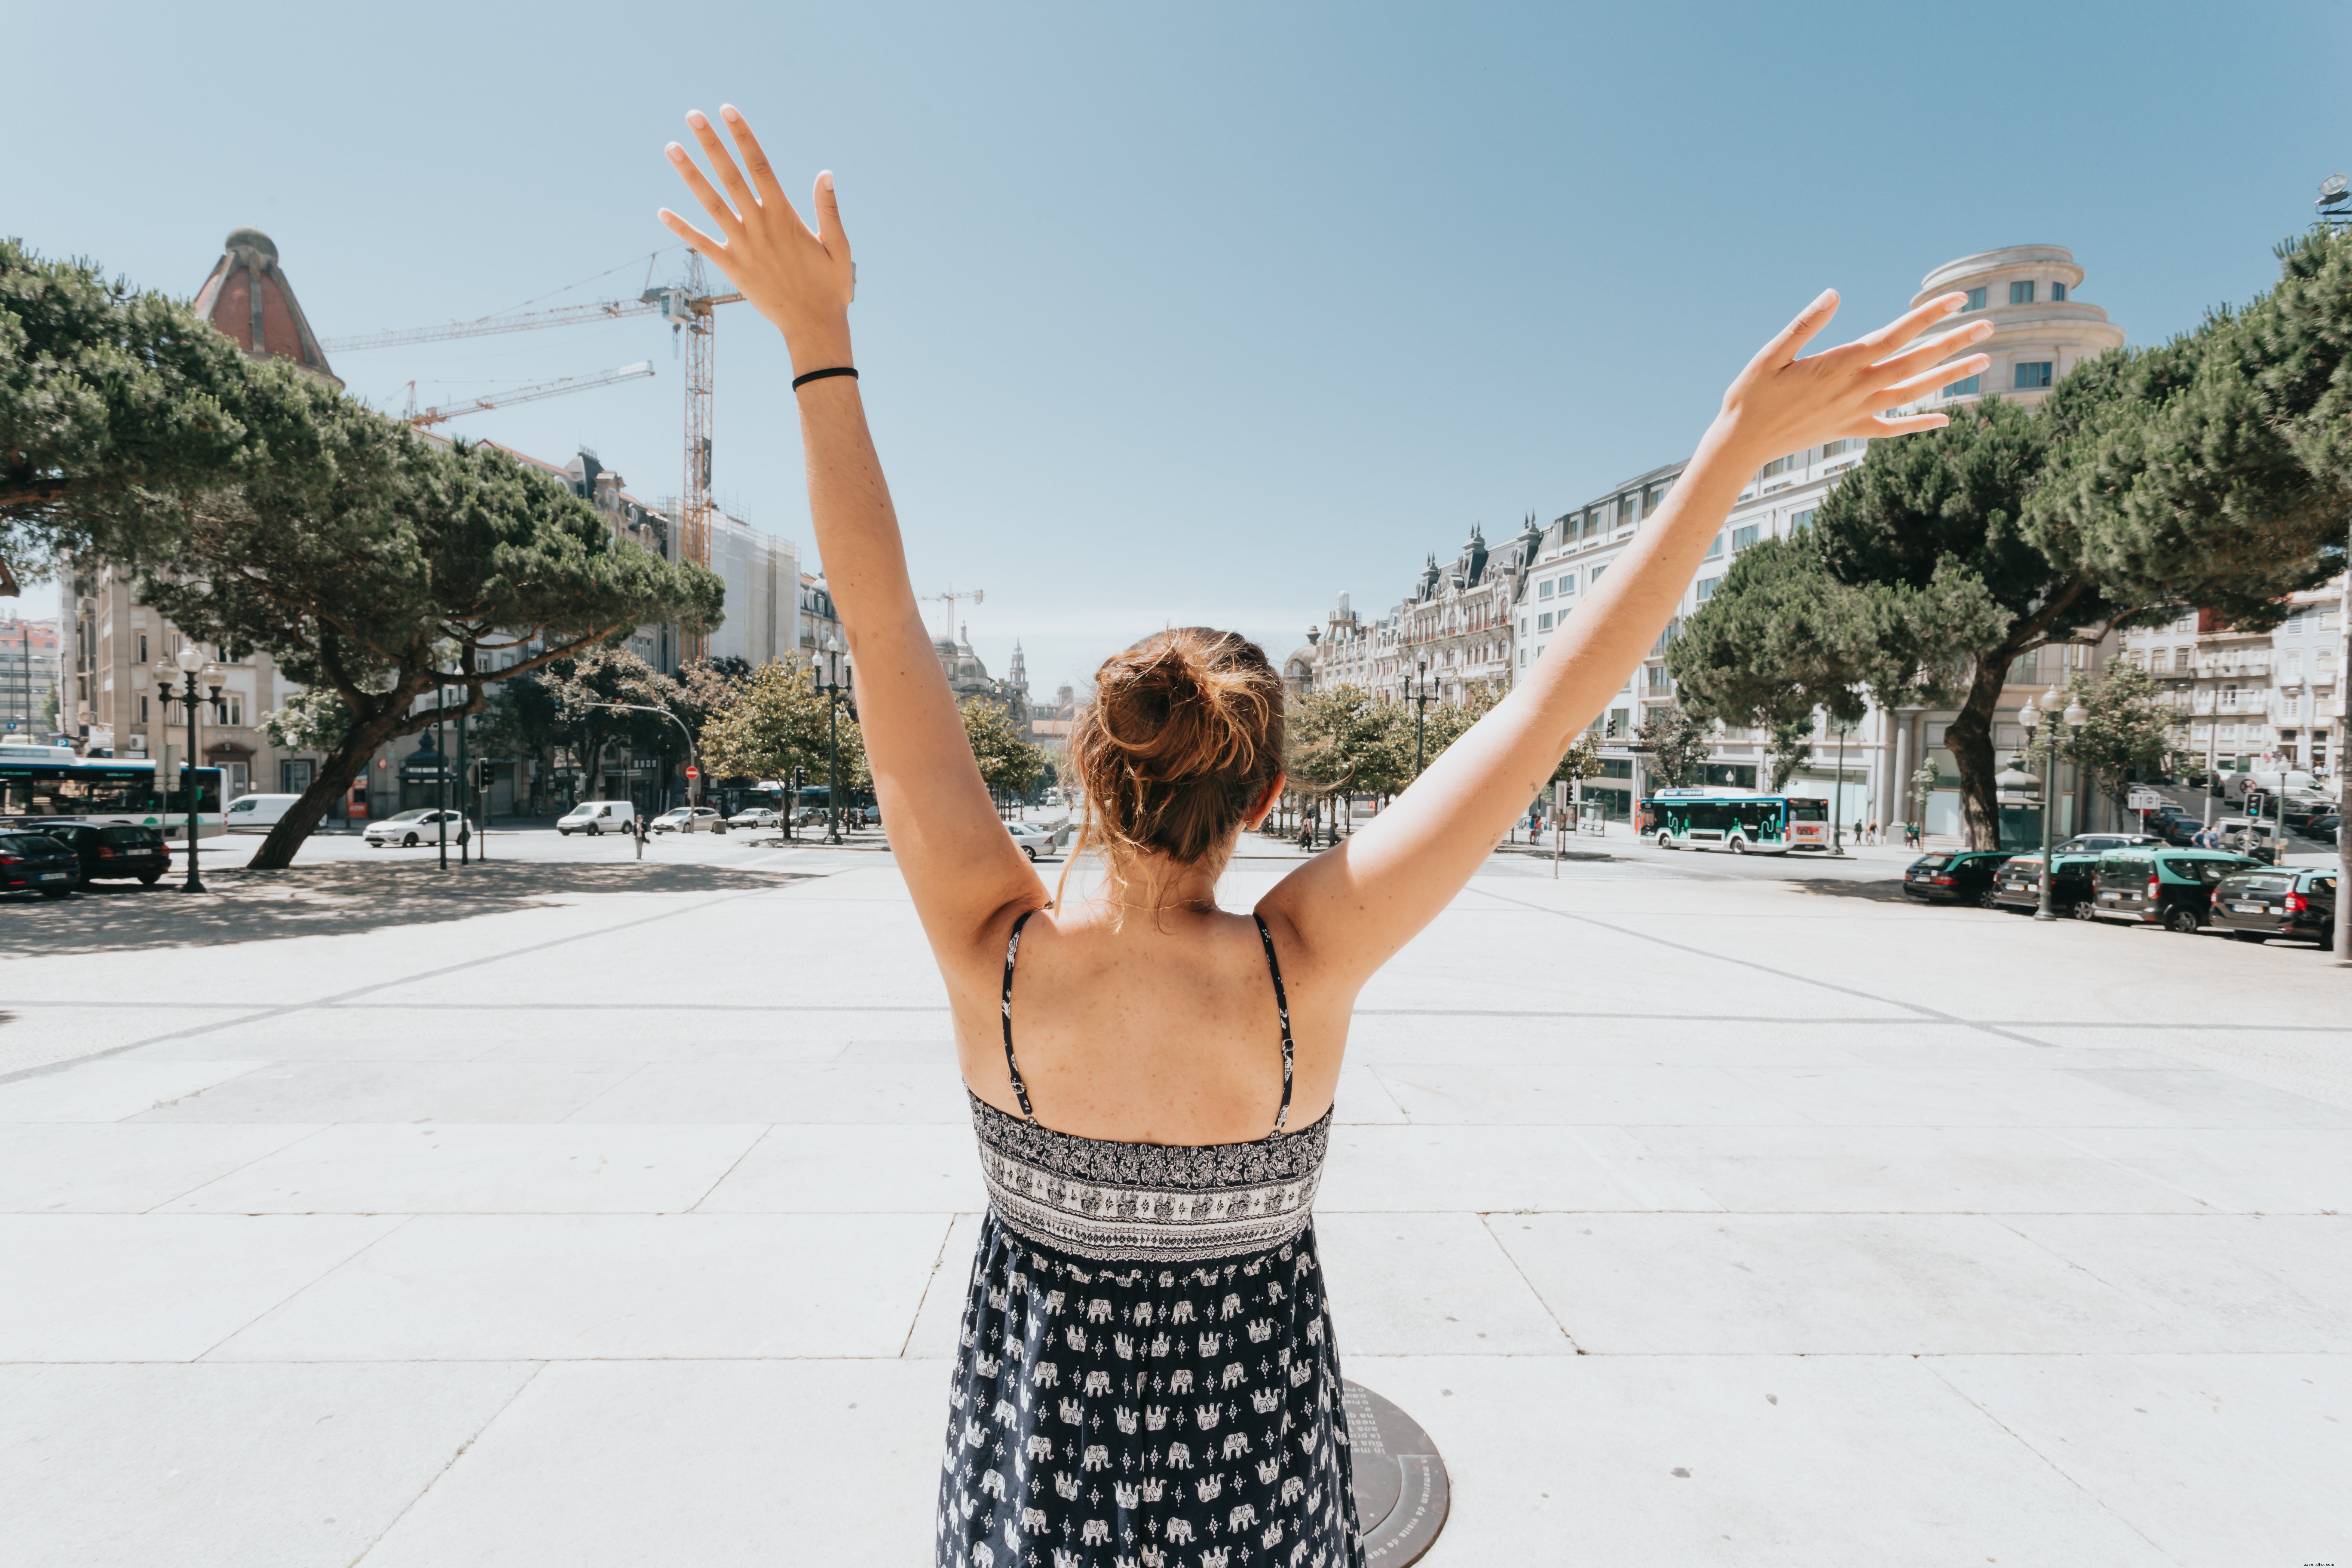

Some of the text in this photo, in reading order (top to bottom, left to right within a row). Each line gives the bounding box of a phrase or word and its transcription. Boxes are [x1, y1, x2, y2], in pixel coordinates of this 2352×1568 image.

[1420, 1466, 1431, 1504] memoriam
[1415, 1506, 1426, 1516] da
[1398, 1518, 1419, 1537] visita
[1366, 1547, 1387, 1560] Sua
